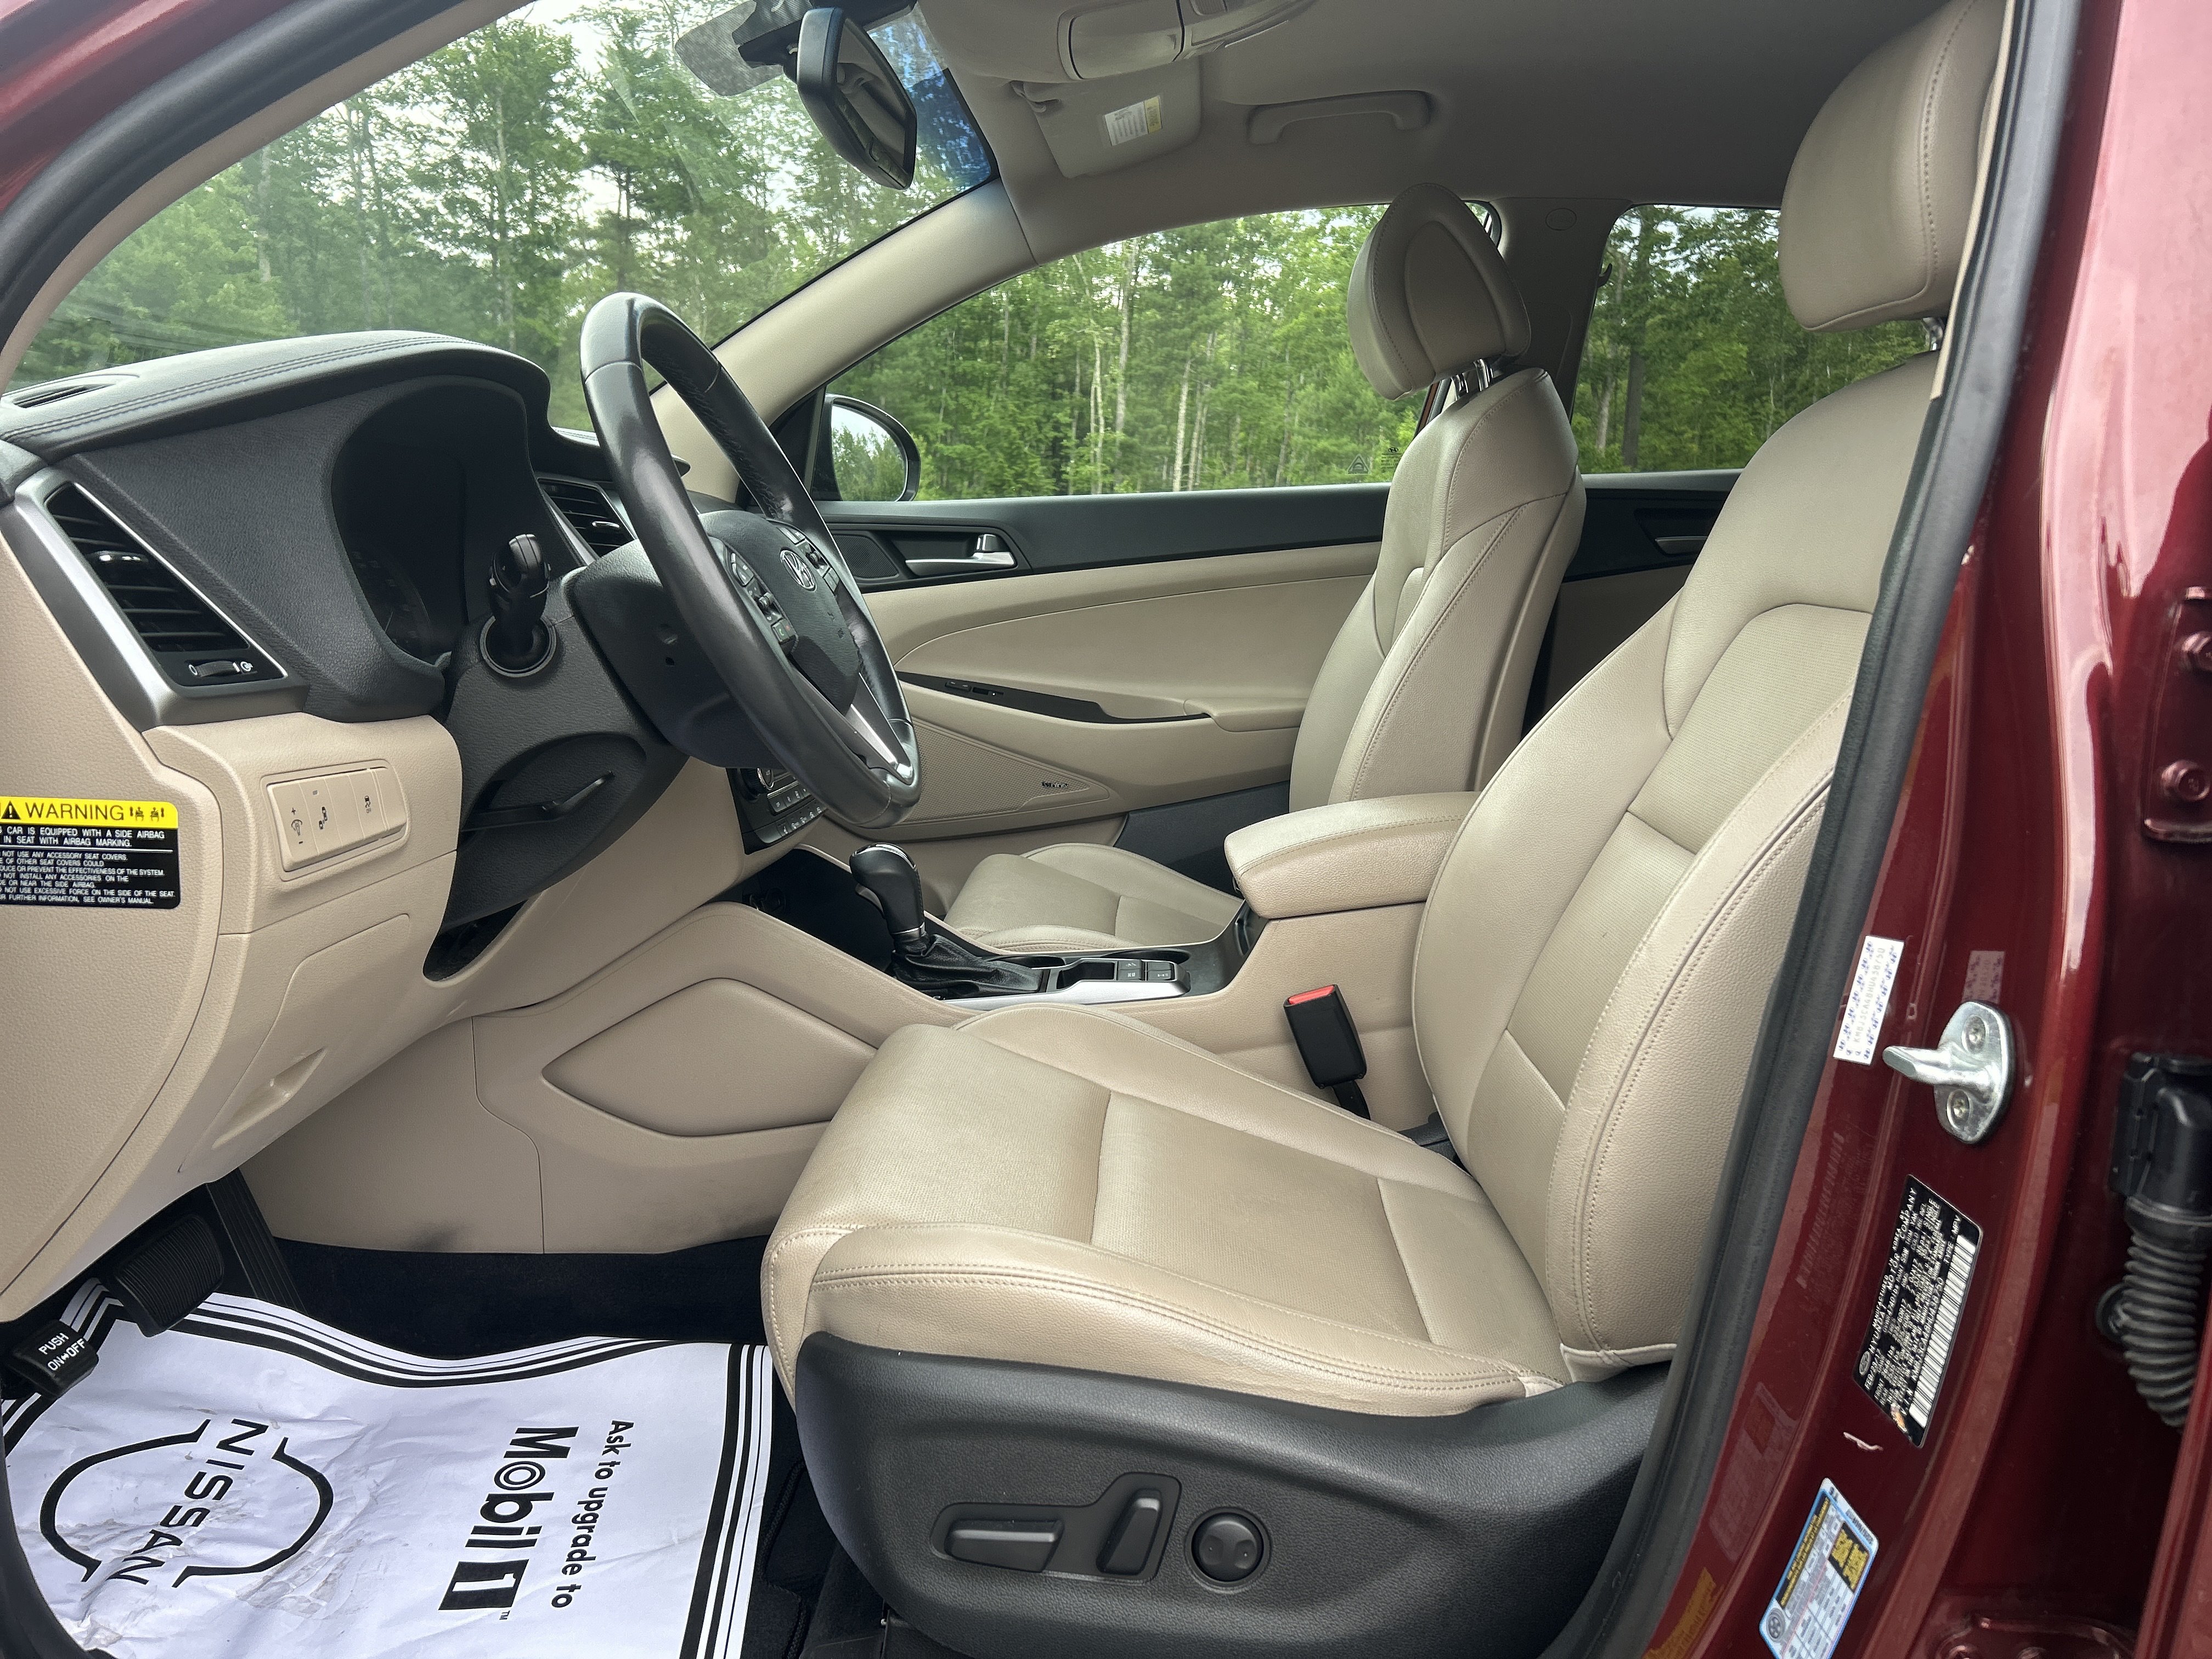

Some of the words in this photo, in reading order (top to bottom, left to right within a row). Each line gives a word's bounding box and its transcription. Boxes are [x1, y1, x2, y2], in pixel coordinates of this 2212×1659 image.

[25, 802, 124, 821] WARNING
[3, 835, 11, 843] IN
[16, 836, 35, 844] SEAT
[40, 837, 59, 845] WITH
[63, 837, 91, 845] AIRBAG
[95, 838, 132, 847] MARKING.
[7, 826, 23, 834] CAR
[40, 827, 78, 836] EQUIPPED
[82, 828, 101, 837] WITH
[106, 829, 112, 838] A
[115, 830, 132, 838] SIDE
[137, 830, 165, 839] AIRBAG
[1923, 1199, 1934, 1227] SINGLE
[1928, 1202, 1939, 1232] SINGLE
[1893, 1228, 1901, 1251] KOREA
[1944, 1242, 1954, 1263] TYPE
[1952, 1215, 1960, 1234] MPV
[1870, 1304, 1886, 1354] HYUNDAI
[1887, 1253, 1900, 1290] MOTOR
[1900, 1188, 1917, 1239] COMPANY
[38, 1333, 69, 1355] PUSH
[47, 1356, 65, 1371] ON
[66, 1338, 85, 1357] OFF
[602, 1420, 634, 1455] Ask
[594, 1460, 621, 1480] to
[107, 1418, 270, 1585] NISSAN
[465, 1426, 579, 1548] Mobil
[561, 1486, 609, 1576] upgrade
[551, 1583, 582, 1609] to
